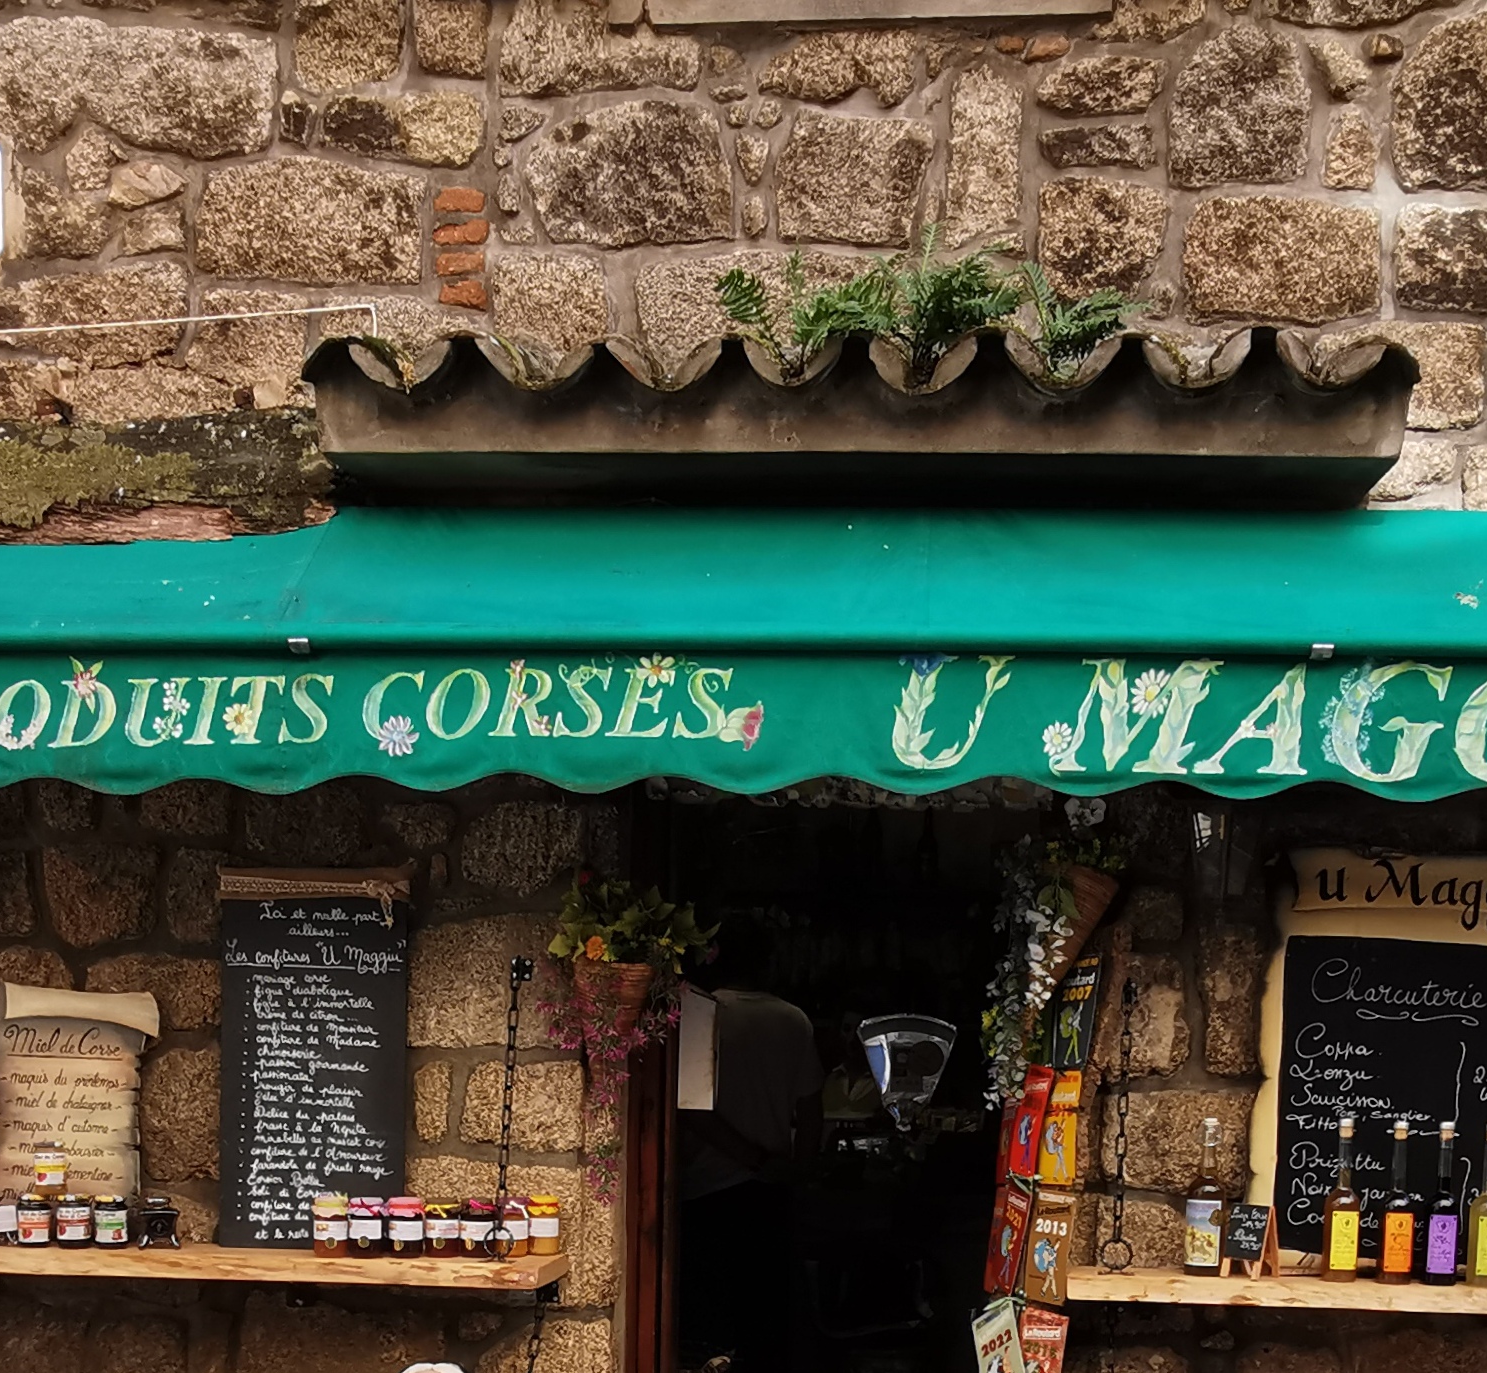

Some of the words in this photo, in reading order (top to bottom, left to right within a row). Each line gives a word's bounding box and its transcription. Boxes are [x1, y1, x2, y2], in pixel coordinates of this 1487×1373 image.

[363, 666, 736, 749] CORSES
[891, 654, 1016, 769] U
[225, 938, 248, 963] Les
[1063, 985, 1094, 1002] 2007
[1311, 958, 1487, 1009] Charcuterie
[3, 1024, 59, 1054] Miel
[60, 1034, 75, 1054] de
[78, 1027, 123, 1057] Corse
[1035, 1218, 1068, 1236] 2013
[981, 1328, 1013, 1358] 2022
